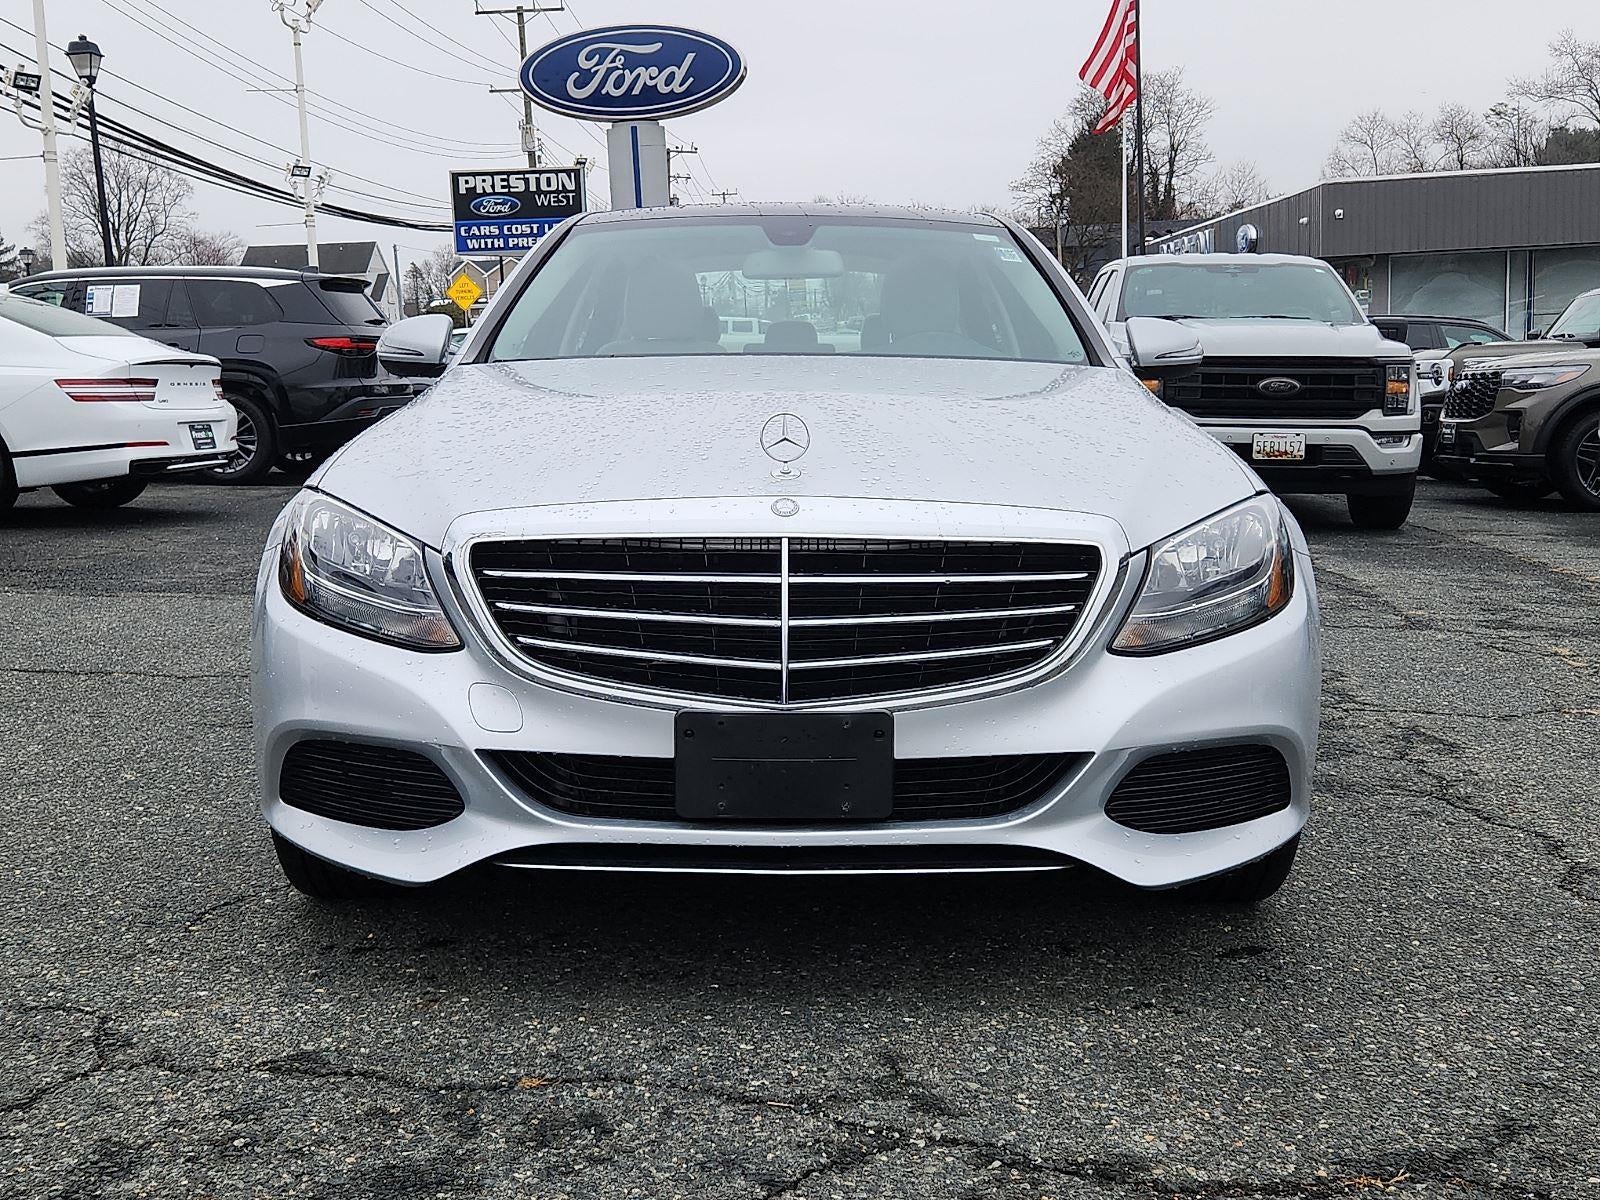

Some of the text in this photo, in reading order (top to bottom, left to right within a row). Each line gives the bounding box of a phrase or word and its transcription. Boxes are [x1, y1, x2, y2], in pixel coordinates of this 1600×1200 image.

[566, 42, 696, 99] Ford
[458, 172, 576, 194] PRESTON
[480, 198, 511, 213] Ford
[535, 193, 576, 207] WEST
[460, 225, 500, 237] CARS
[503, 223, 540, 235] COST
[466, 238, 505, 250] WITH
